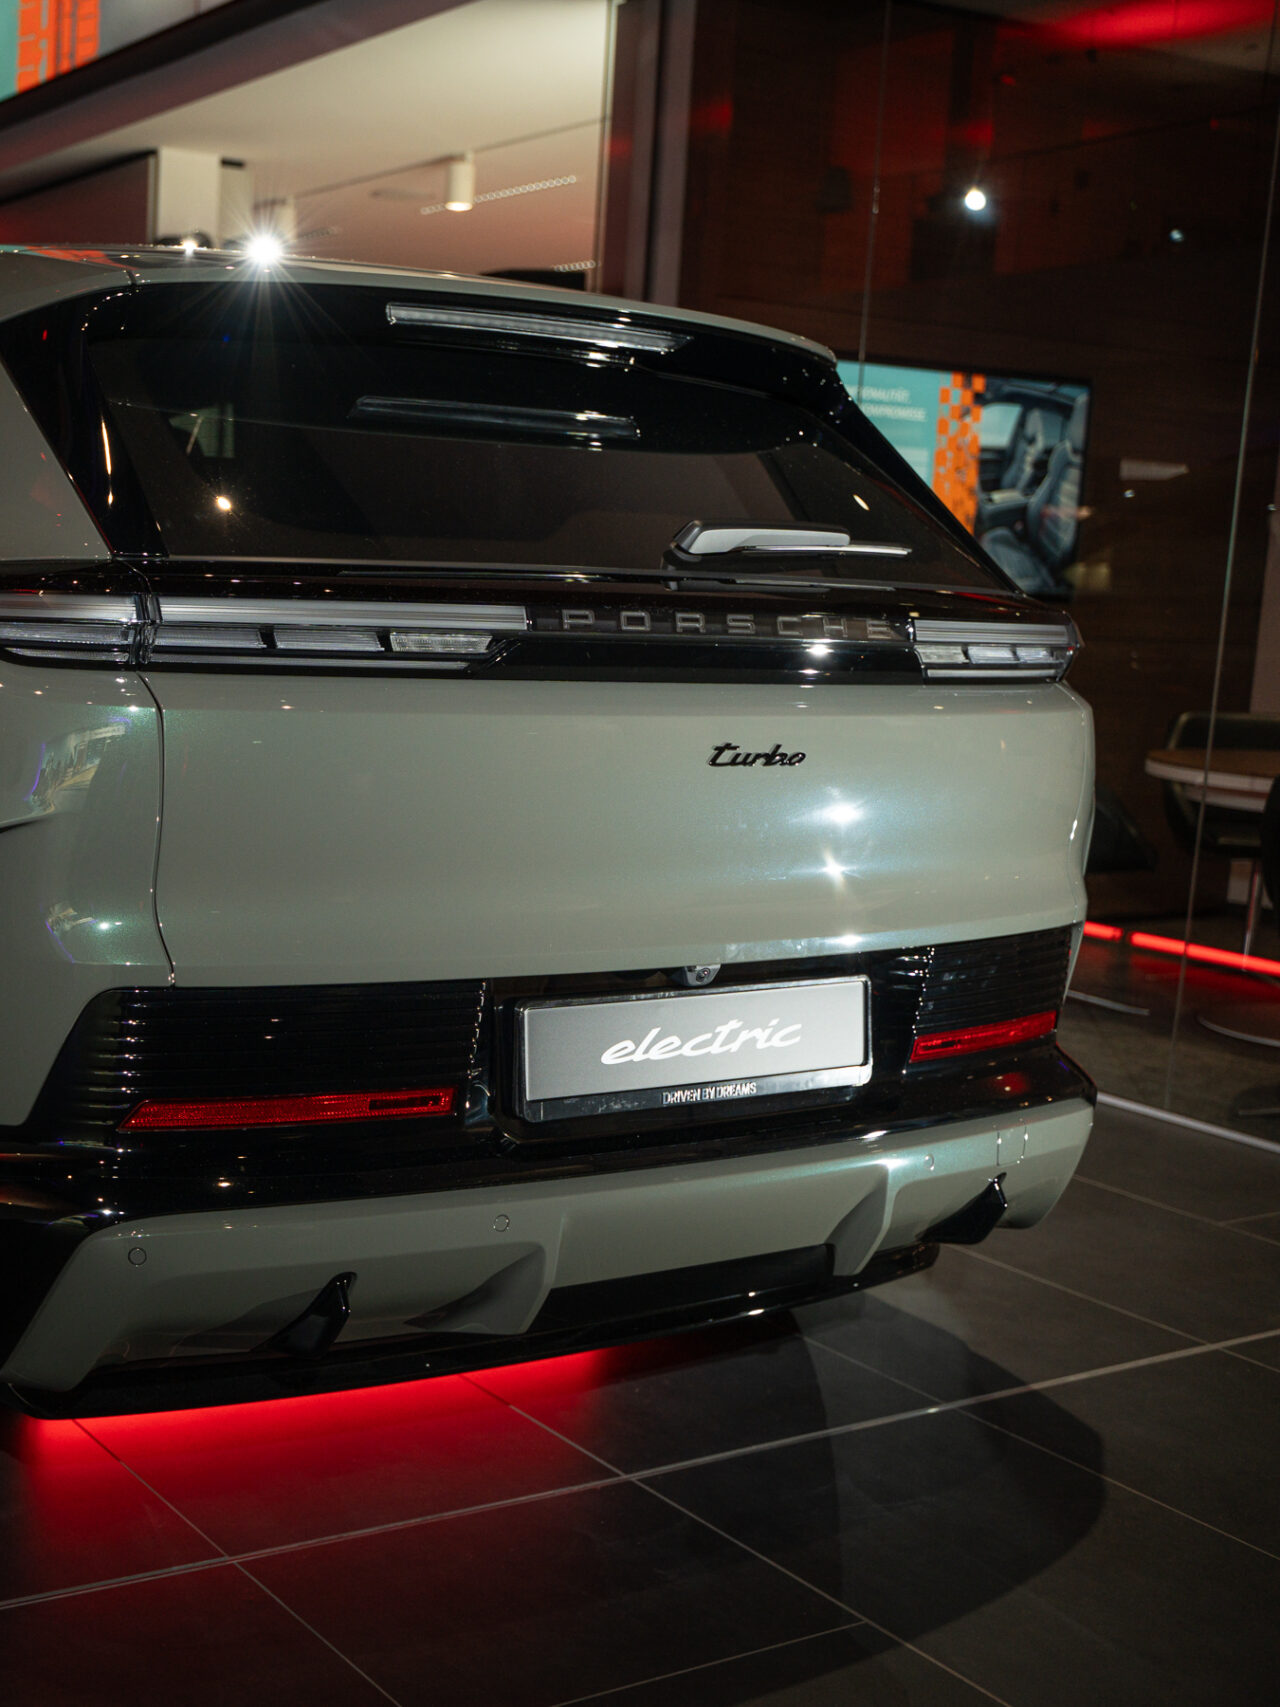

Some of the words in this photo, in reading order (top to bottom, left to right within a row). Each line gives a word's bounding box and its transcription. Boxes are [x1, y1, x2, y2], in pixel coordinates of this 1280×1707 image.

[561, 609, 892, 639] PORSCHE
[708, 742, 806, 767] turbo
[600, 1018, 803, 1065] electric
[662, 1088, 701, 1105] DRIVEN
[702, 1085, 716, 1100] BY
[716, 1082, 757, 1098] DREAMS
